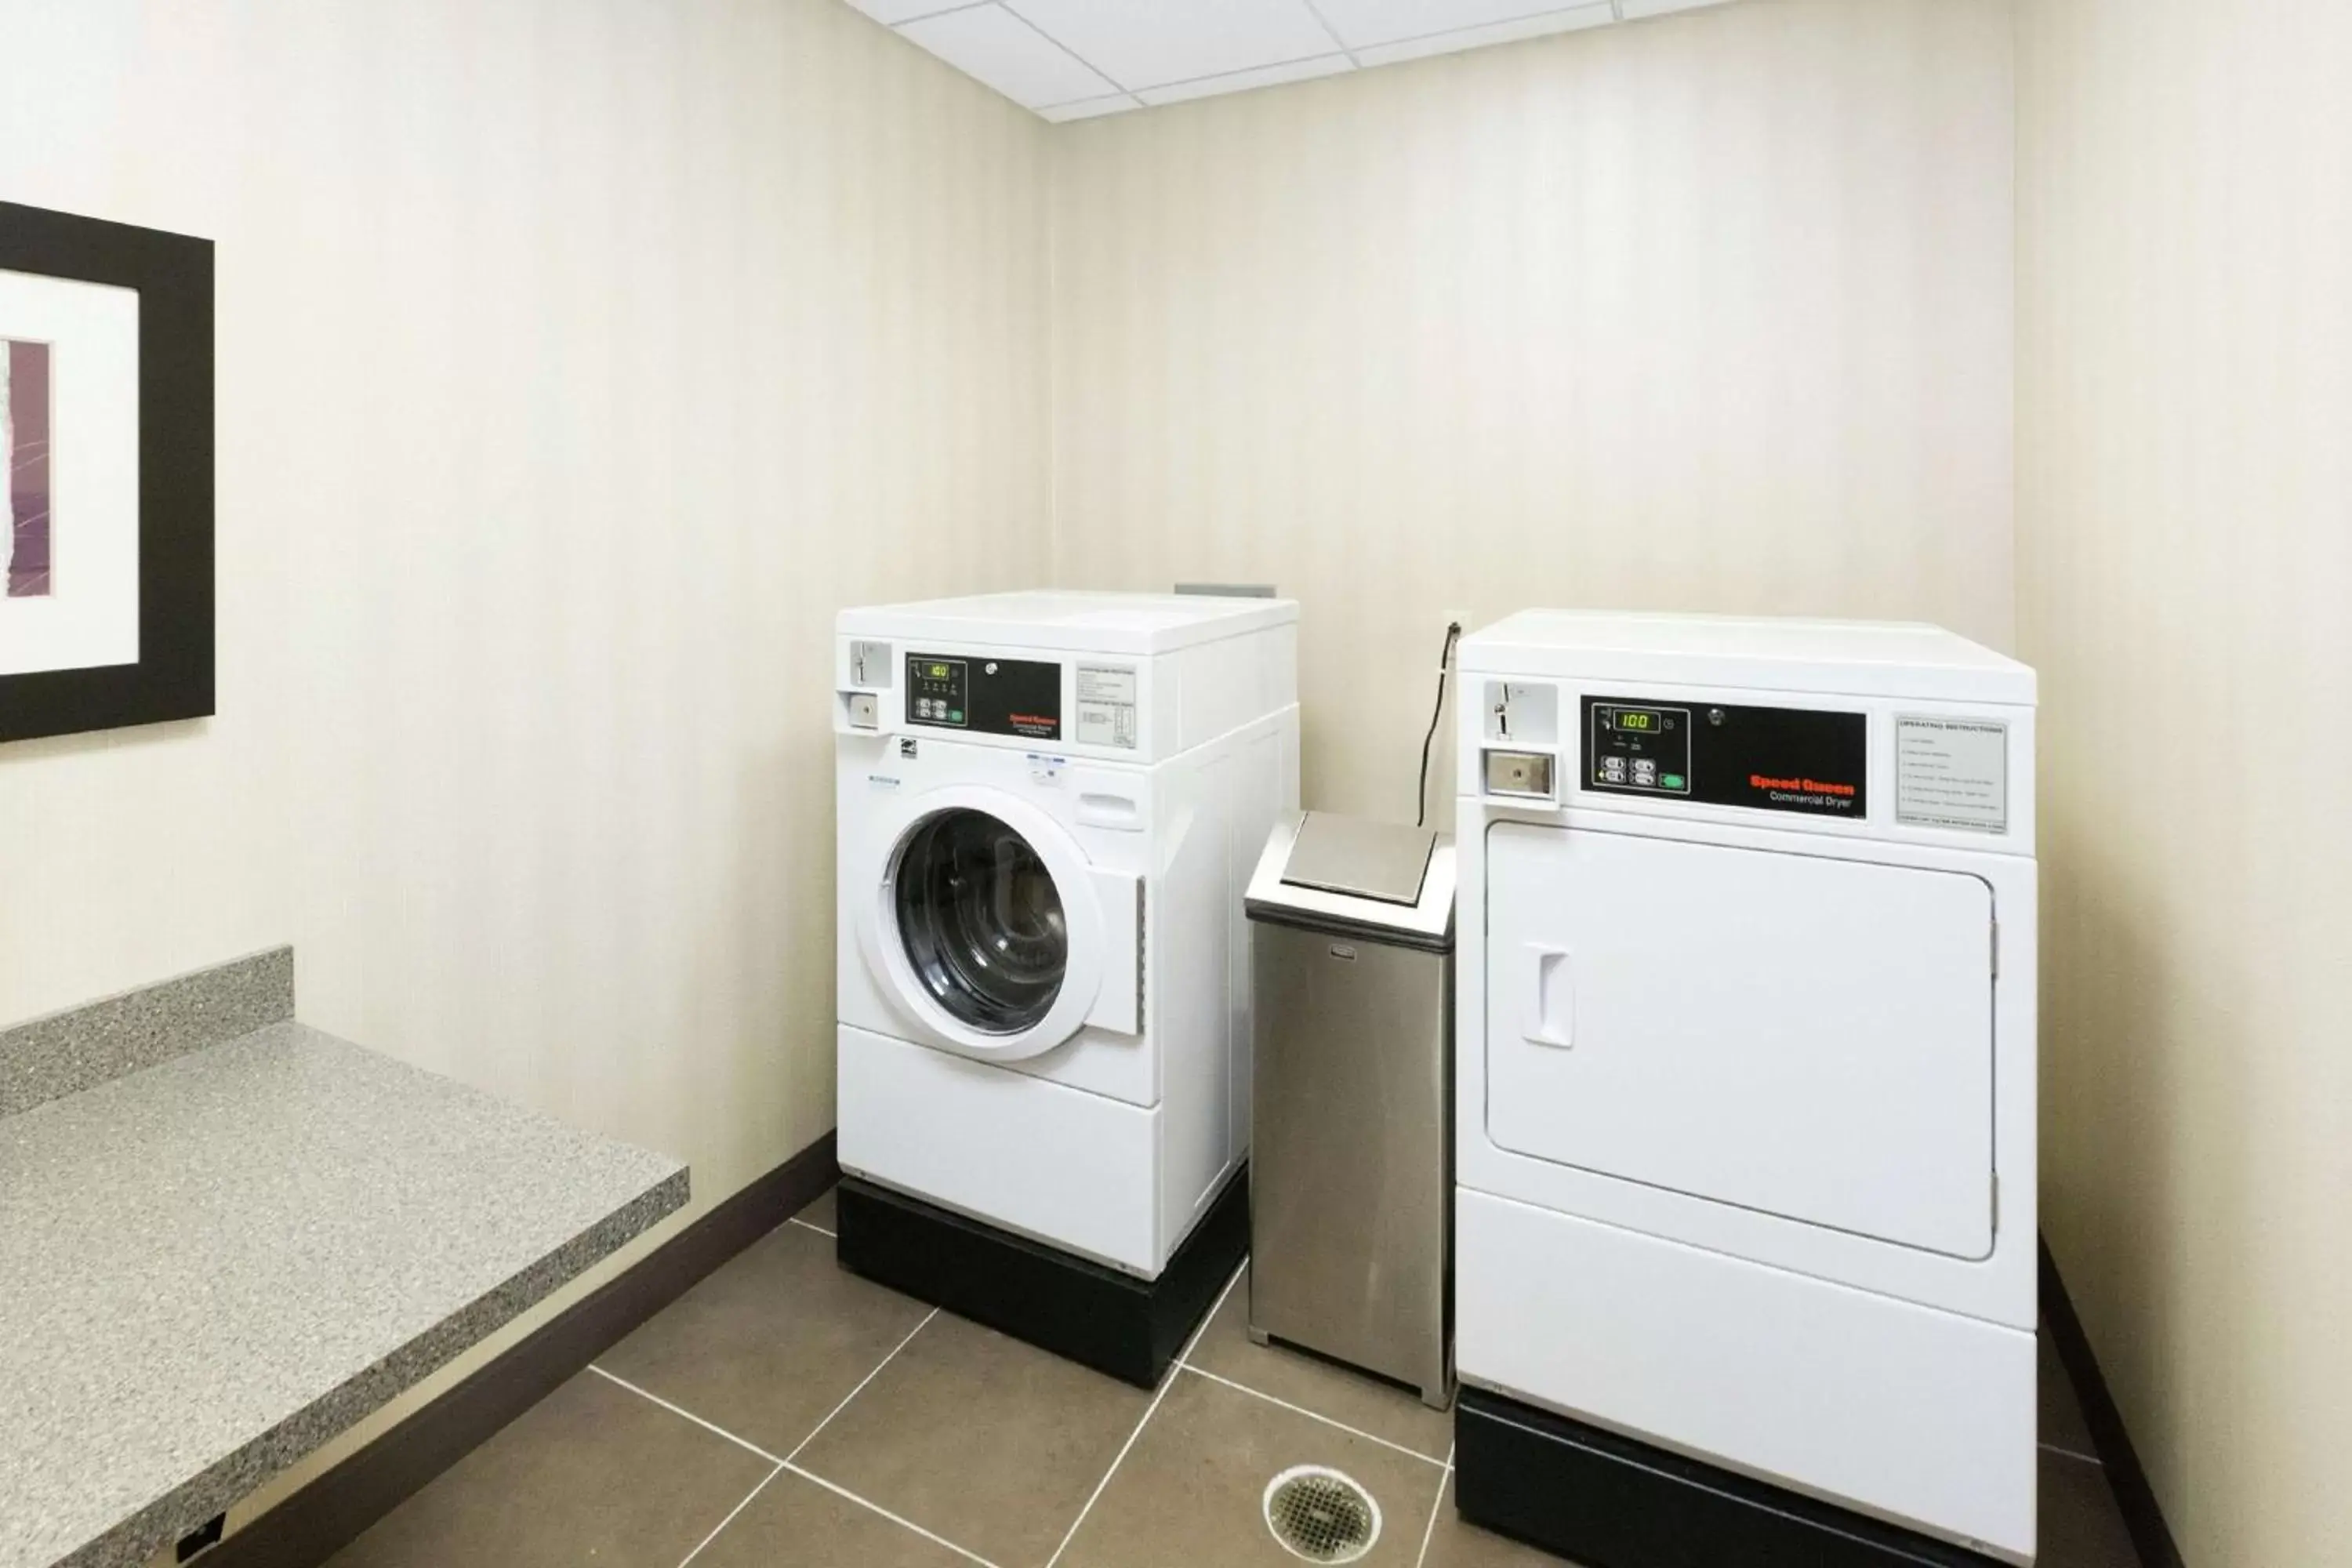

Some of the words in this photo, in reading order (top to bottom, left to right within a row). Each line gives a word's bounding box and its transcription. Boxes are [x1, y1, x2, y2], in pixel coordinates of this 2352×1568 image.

[1622, 714, 1648, 728] 100
[1751, 775, 1800, 789] Speed
[1803, 779, 1854, 795] Queen
[1769, 790, 1823, 804] Commercial
[1826, 796, 1853, 808] Dryer
